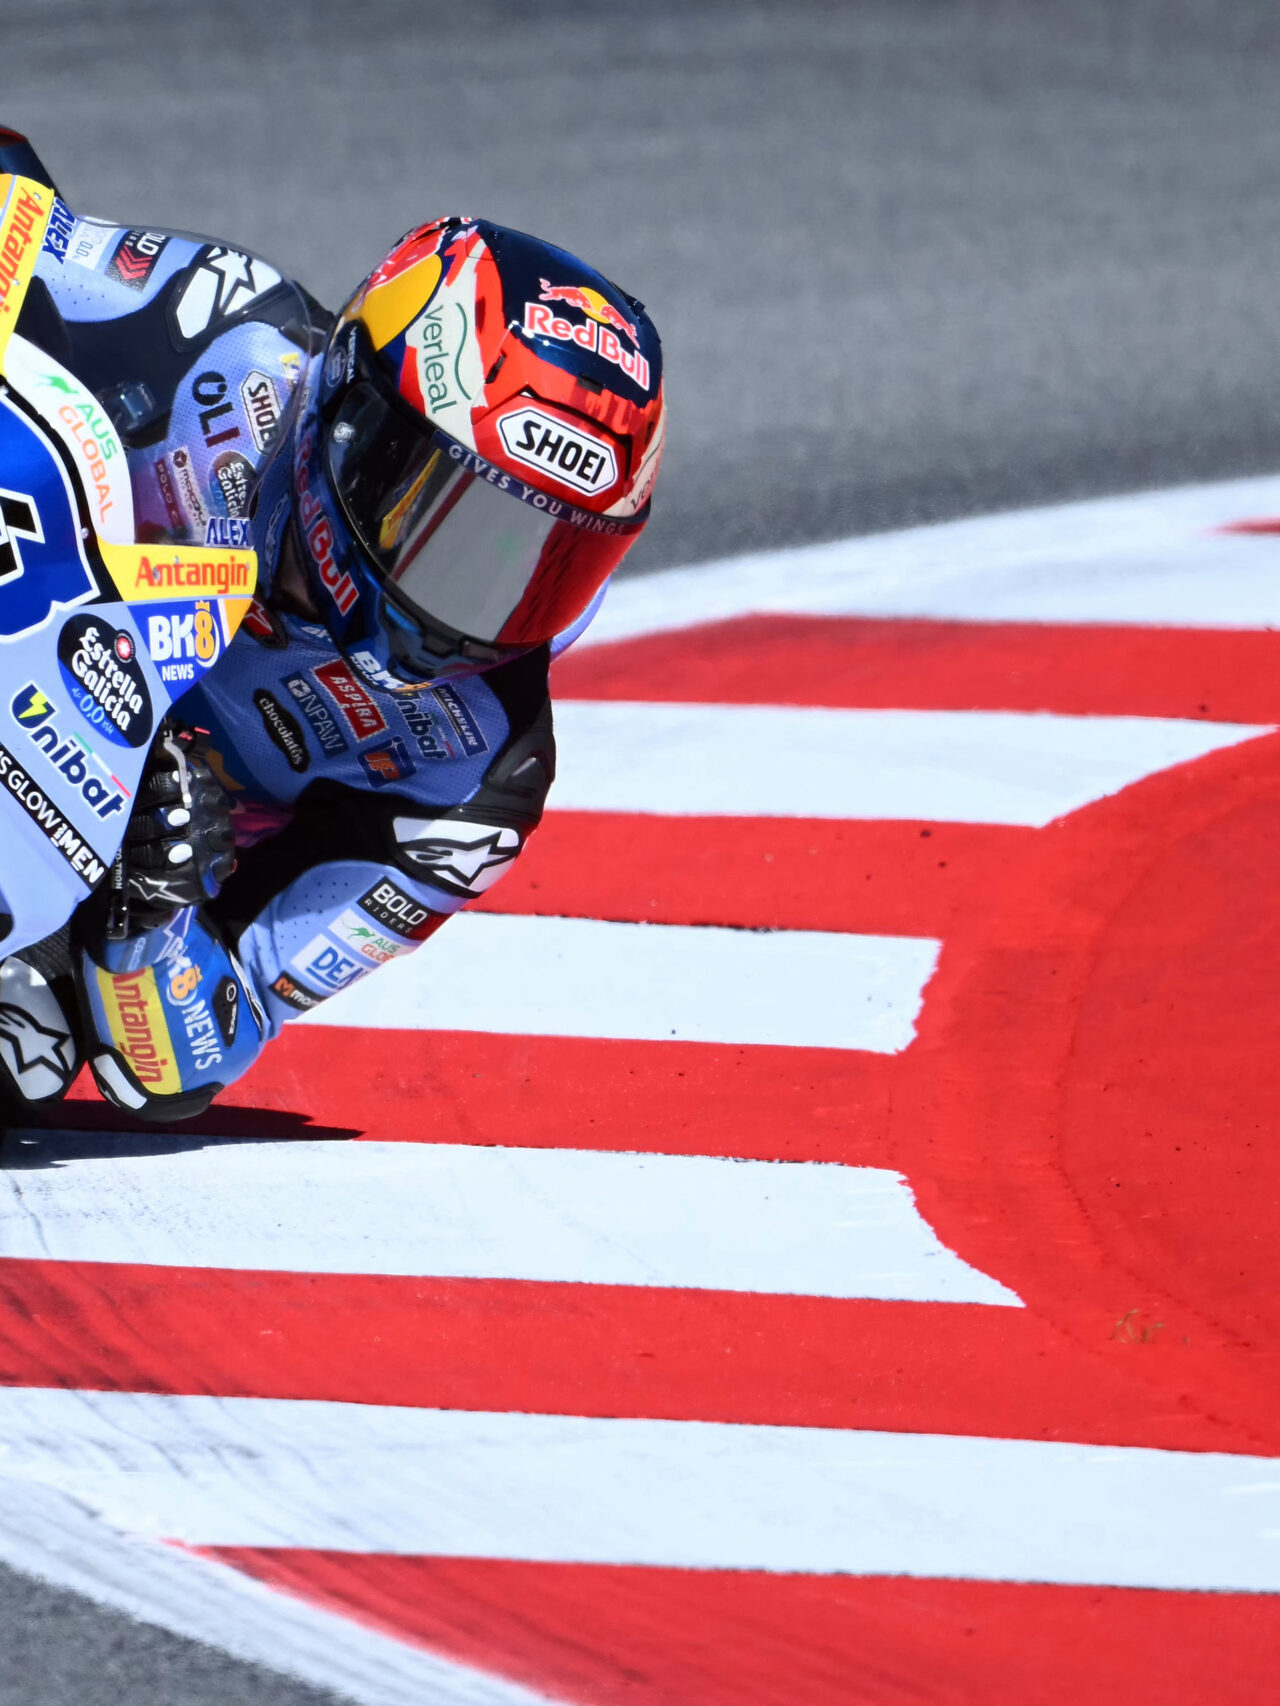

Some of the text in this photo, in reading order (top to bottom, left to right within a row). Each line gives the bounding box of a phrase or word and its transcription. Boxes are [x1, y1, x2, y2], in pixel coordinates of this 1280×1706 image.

[41, 196, 77, 265] ALEX
[423, 304, 458, 415] verleal
[524, 301, 650, 391] Red Bull
[58, 404, 113, 524] GLOBAL
[75, 402, 118, 461] AUS
[515, 420, 607, 485] SHOEI
[448, 443, 511, 491] GIVES
[521, 484, 564, 517] YOU
[206, 518, 250, 546] ALEX
[135, 555, 248, 595] Antangin
[308, 515, 360, 618] Bull
[148, 609, 216, 662] BK8
[71, 648, 131, 731] Galicia
[78, 626, 144, 715] Estrella
[161, 663, 195, 682] NEWS
[330, 675, 378, 729] ASPIRA
[300, 694, 346, 751] NPAW
[394, 690, 449, 760] nibat
[434, 687, 479, 747] MICHELIN
[11, 683, 125, 819] Unibat
[7, 770, 61, 830] GLOW
[58, 828, 105, 884] MEN
[115, 847, 124, 890] TO-TRON
[364, 898, 412, 935] RIDERS
[372, 883, 428, 926] BOLD
[372, 937, 402, 953] AUS
[181, 999, 223, 1071] NEWS
